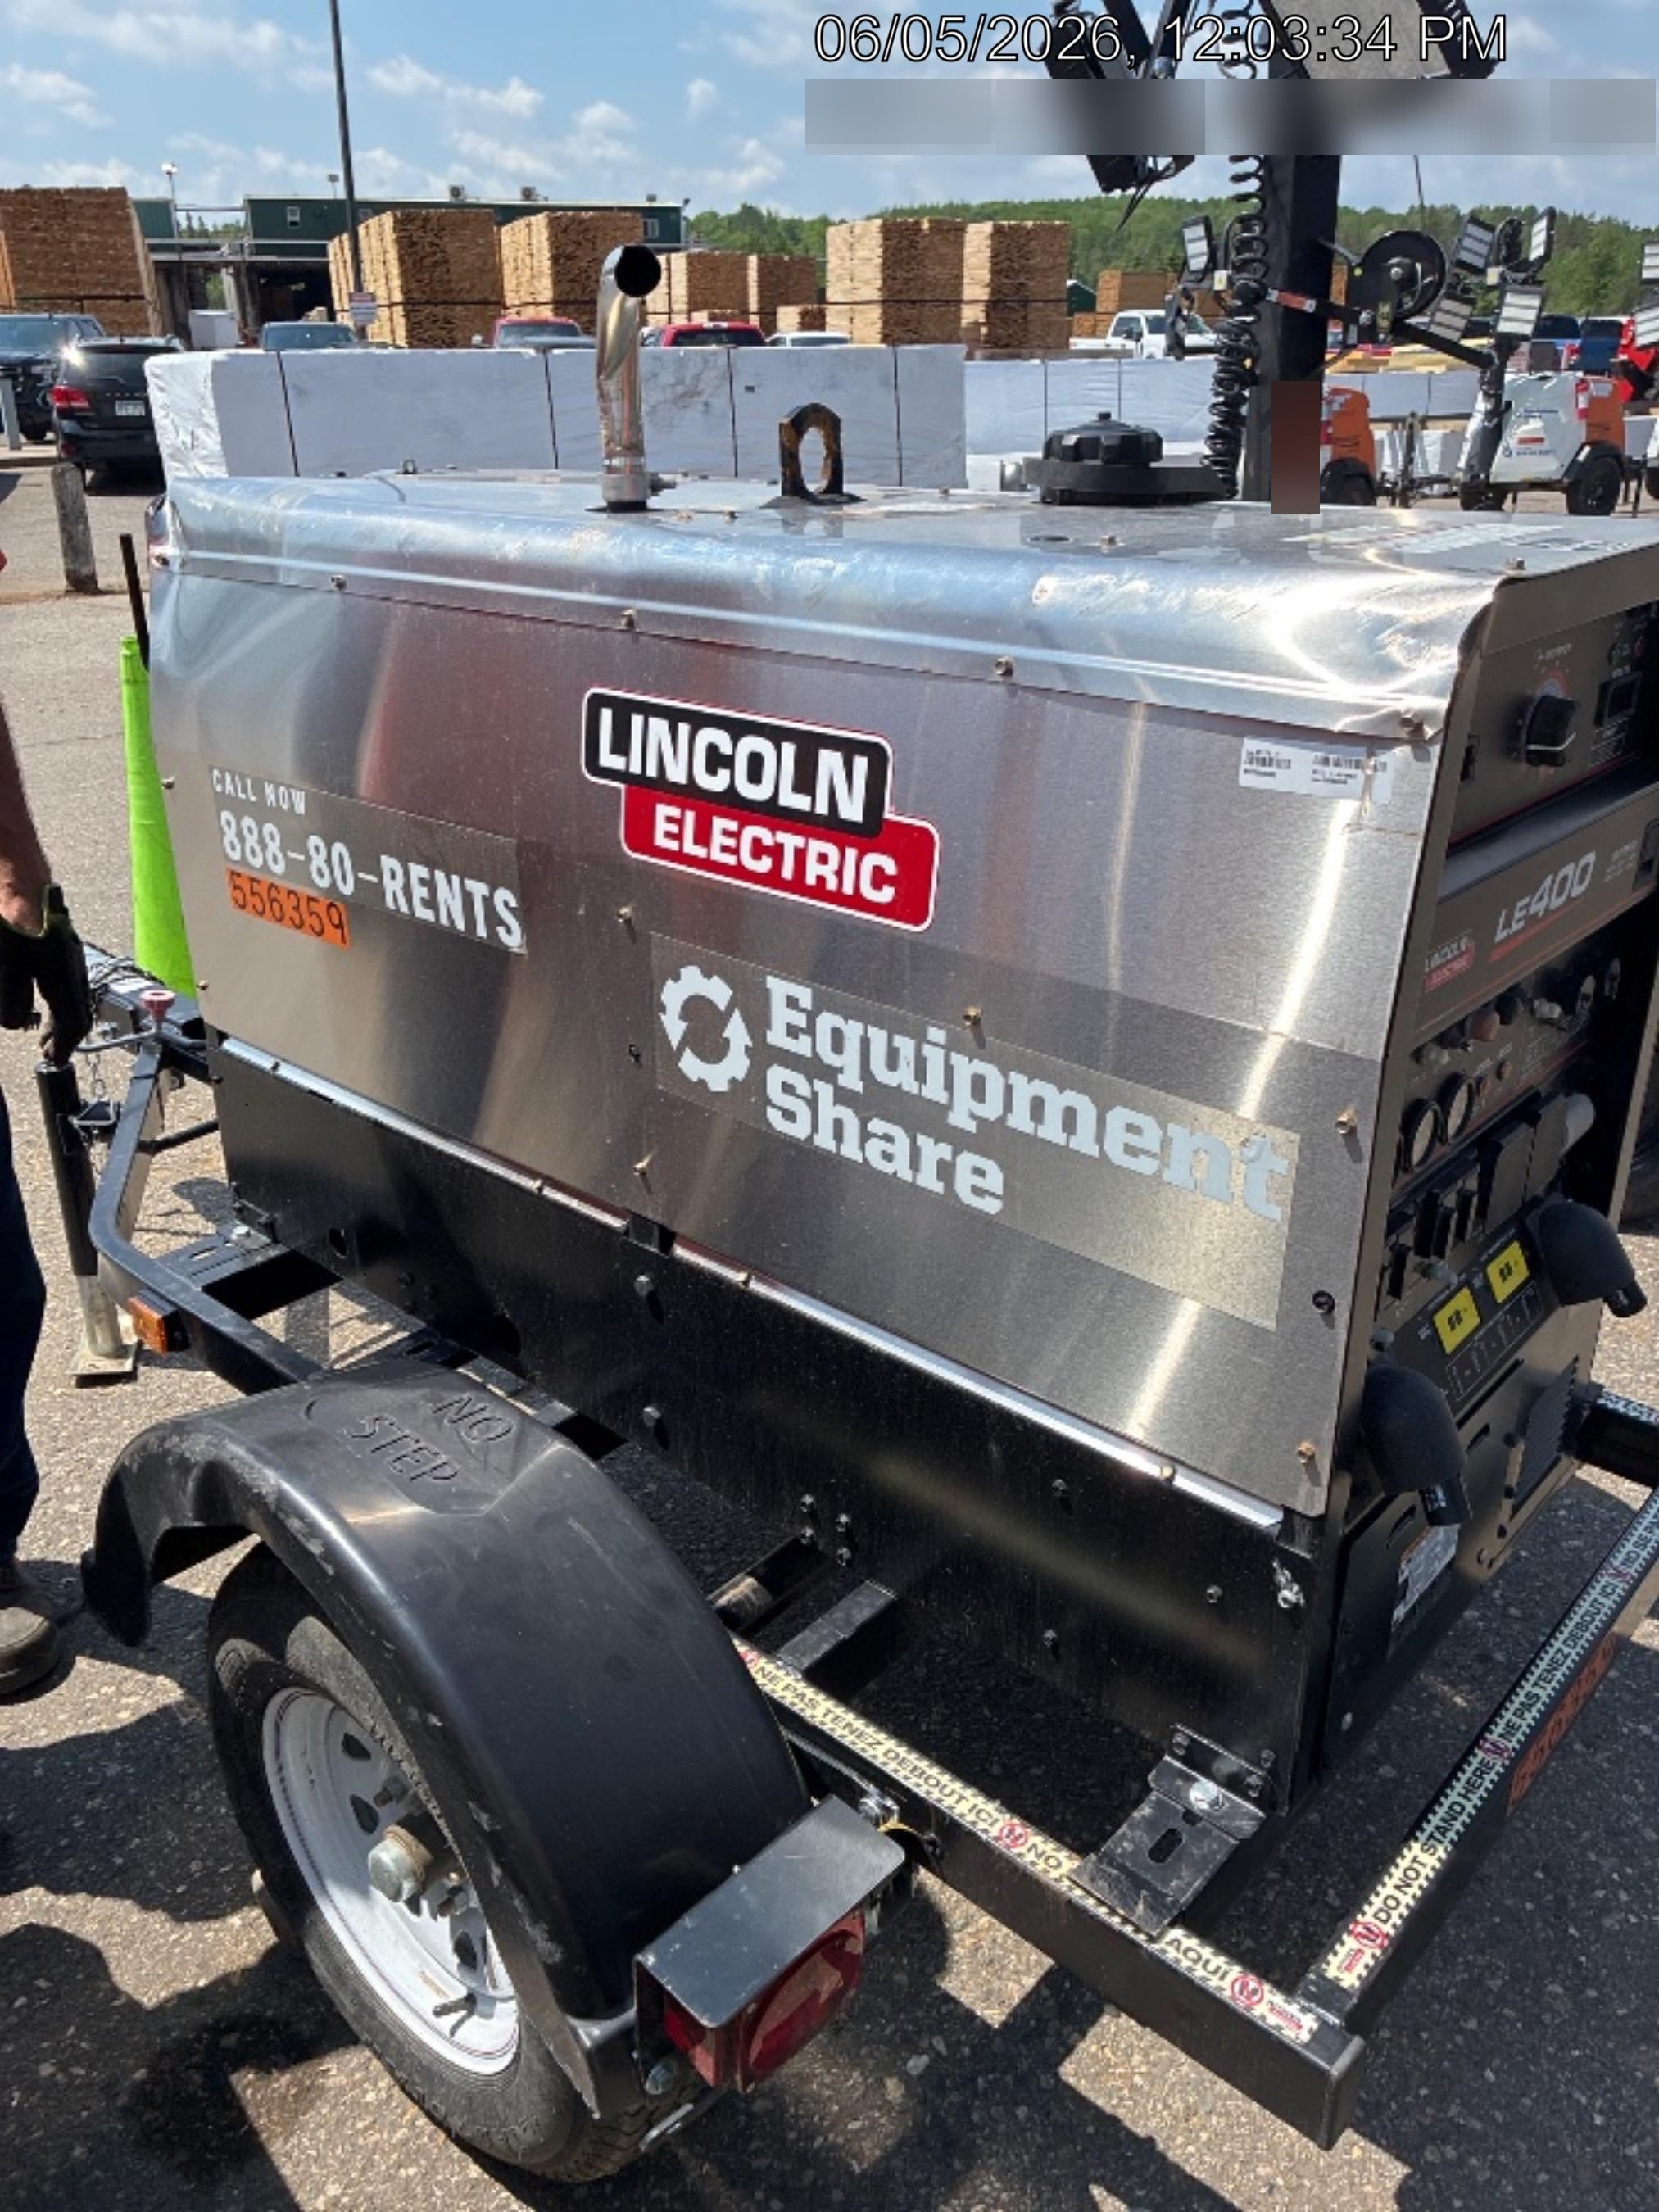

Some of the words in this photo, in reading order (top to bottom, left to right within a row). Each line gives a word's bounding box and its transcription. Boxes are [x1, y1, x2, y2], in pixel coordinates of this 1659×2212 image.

[212, 768, 257, 802] CALL
[265, 781, 306, 815] NOW
[598, 707, 868, 824] LINCOLN
[219, 809, 524, 948] 888-80-RENTS
[654, 802, 898, 904] ELECTRIC
[1494, 850, 1597, 943] LE400
[229, 870, 347, 945] 556359
[765, 974, 1289, 1222] Equipment
[765, 1063, 1004, 1215] Share
[342, 1413, 460, 1483] STEP
[432, 1394, 517, 1443] NO
[1373, 1894, 1401, 1925] DO
[1393, 1856, 1429, 1897] NOT
[1421, 1801, 1466, 1856] STAND
[1512, 1690, 1542, 1720] PAS
[1531, 1648, 1572, 1693] TENEZ
[1027, 1843, 1063, 1870] NO
